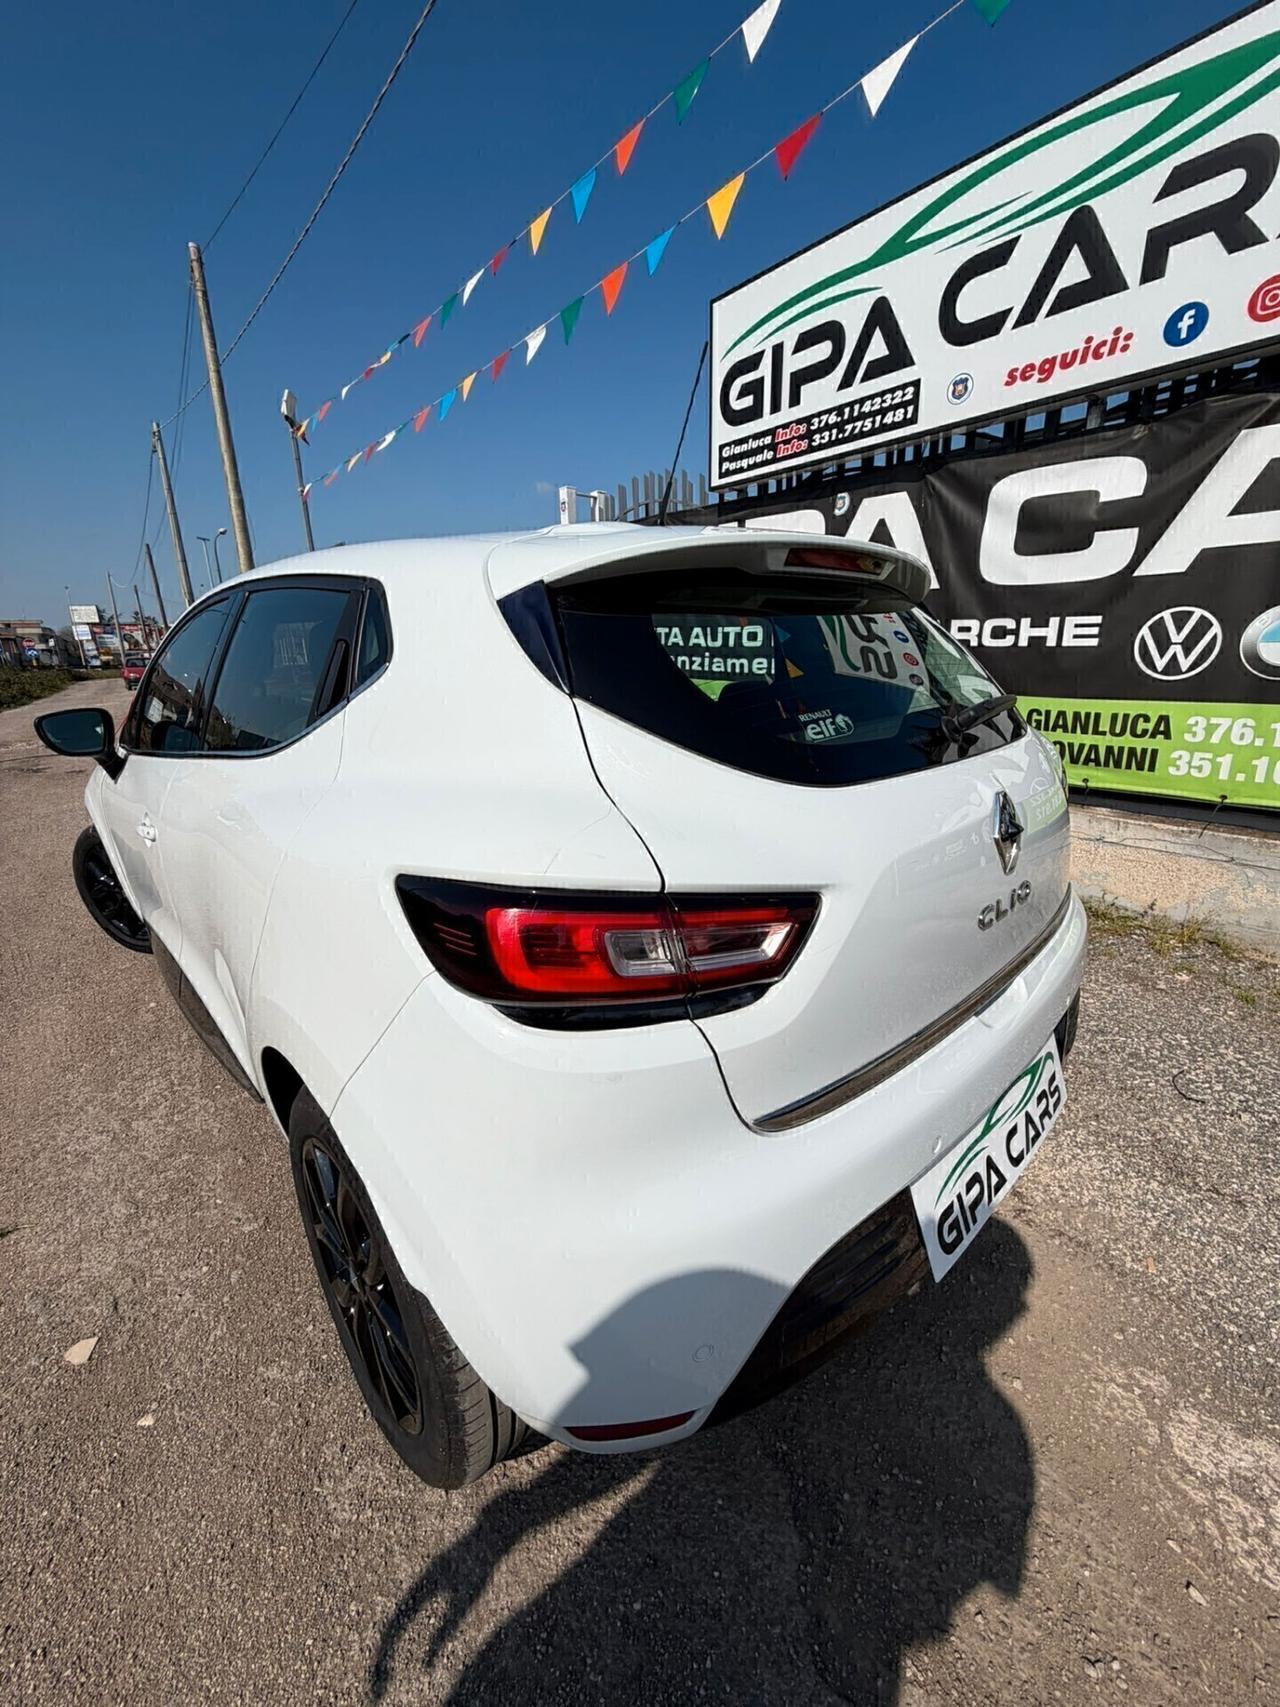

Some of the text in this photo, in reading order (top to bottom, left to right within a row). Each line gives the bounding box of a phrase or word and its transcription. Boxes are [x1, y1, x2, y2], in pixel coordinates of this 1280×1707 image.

[720, 132, 1280, 427] GIPA CAR
[1004, 326, 1134, 387] seguici:
[722, 386, 915, 458] Gianluca Info: 376.1142322
[722, 404, 914, 473] Pasquale Info: 331.7751481
[688, 625, 763, 648] AUTO
[938, 615, 1103, 648] RCHE
[670, 652, 775, 674] nziame
[798, 709, 832, 722] RENAULT
[806, 718, 836, 739] elf
[1026, 708, 1172, 740] GIANLUCA
[1168, 750, 1280, 784] 351.1
[977, 879, 1032, 932] CLIO
[937, 1070, 1061, 1255] GIPA CARS
